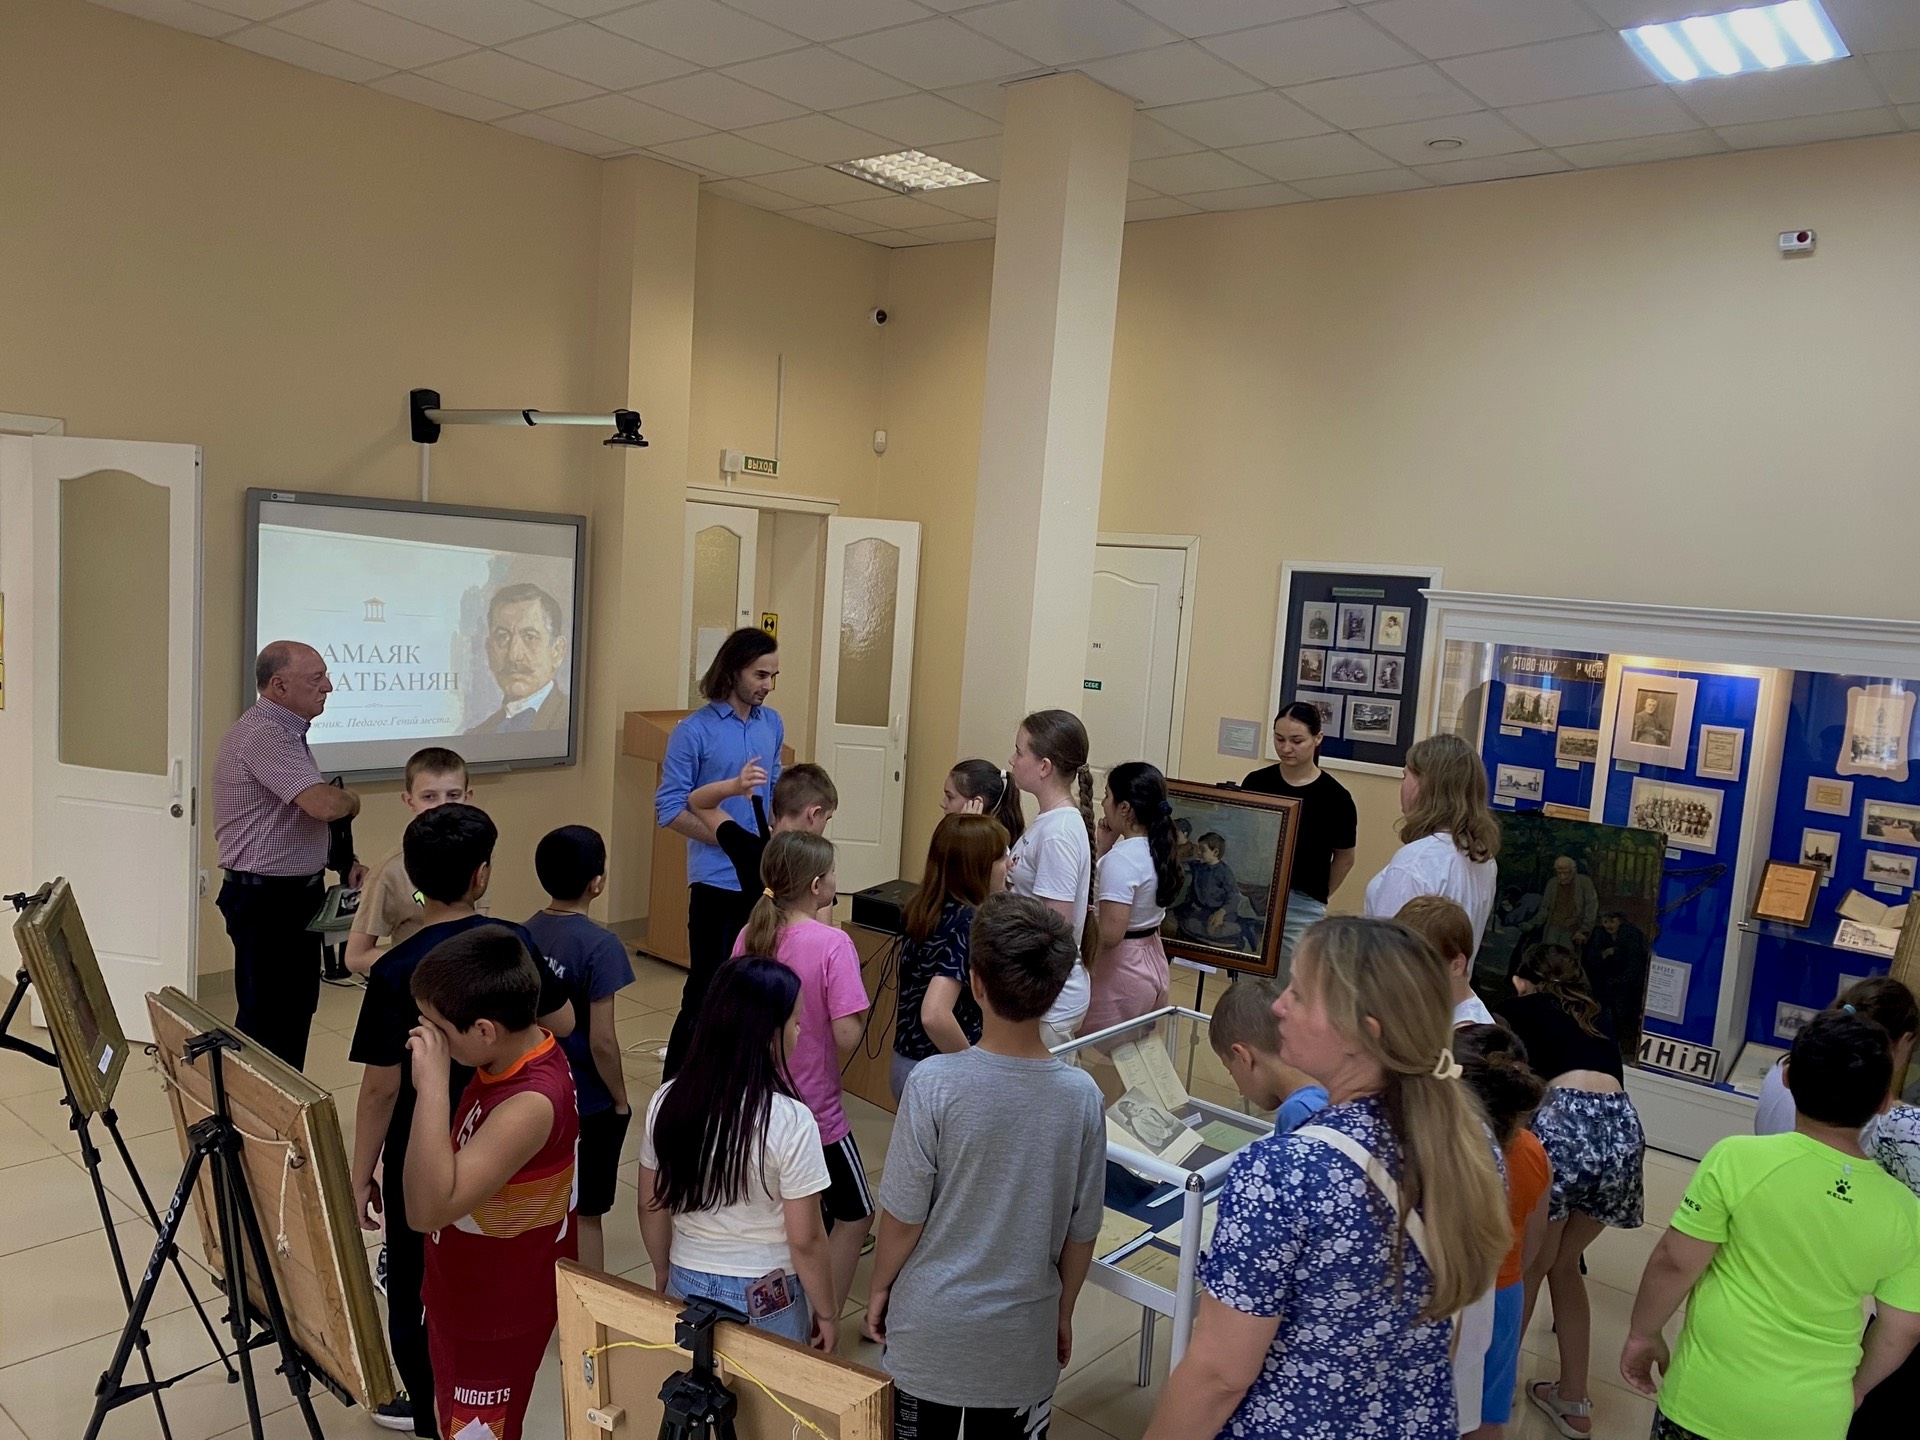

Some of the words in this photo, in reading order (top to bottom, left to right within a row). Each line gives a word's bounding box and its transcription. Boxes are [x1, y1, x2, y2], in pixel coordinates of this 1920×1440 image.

[747, 459, 773, 473] ВЫХОД
[322, 643, 421, 664] АМАЯК
[327, 672, 460, 692] АТБАНЯН
[1826, 1190, 1854, 1205] KELME
[453, 1386, 511, 1406] NUGGETS
